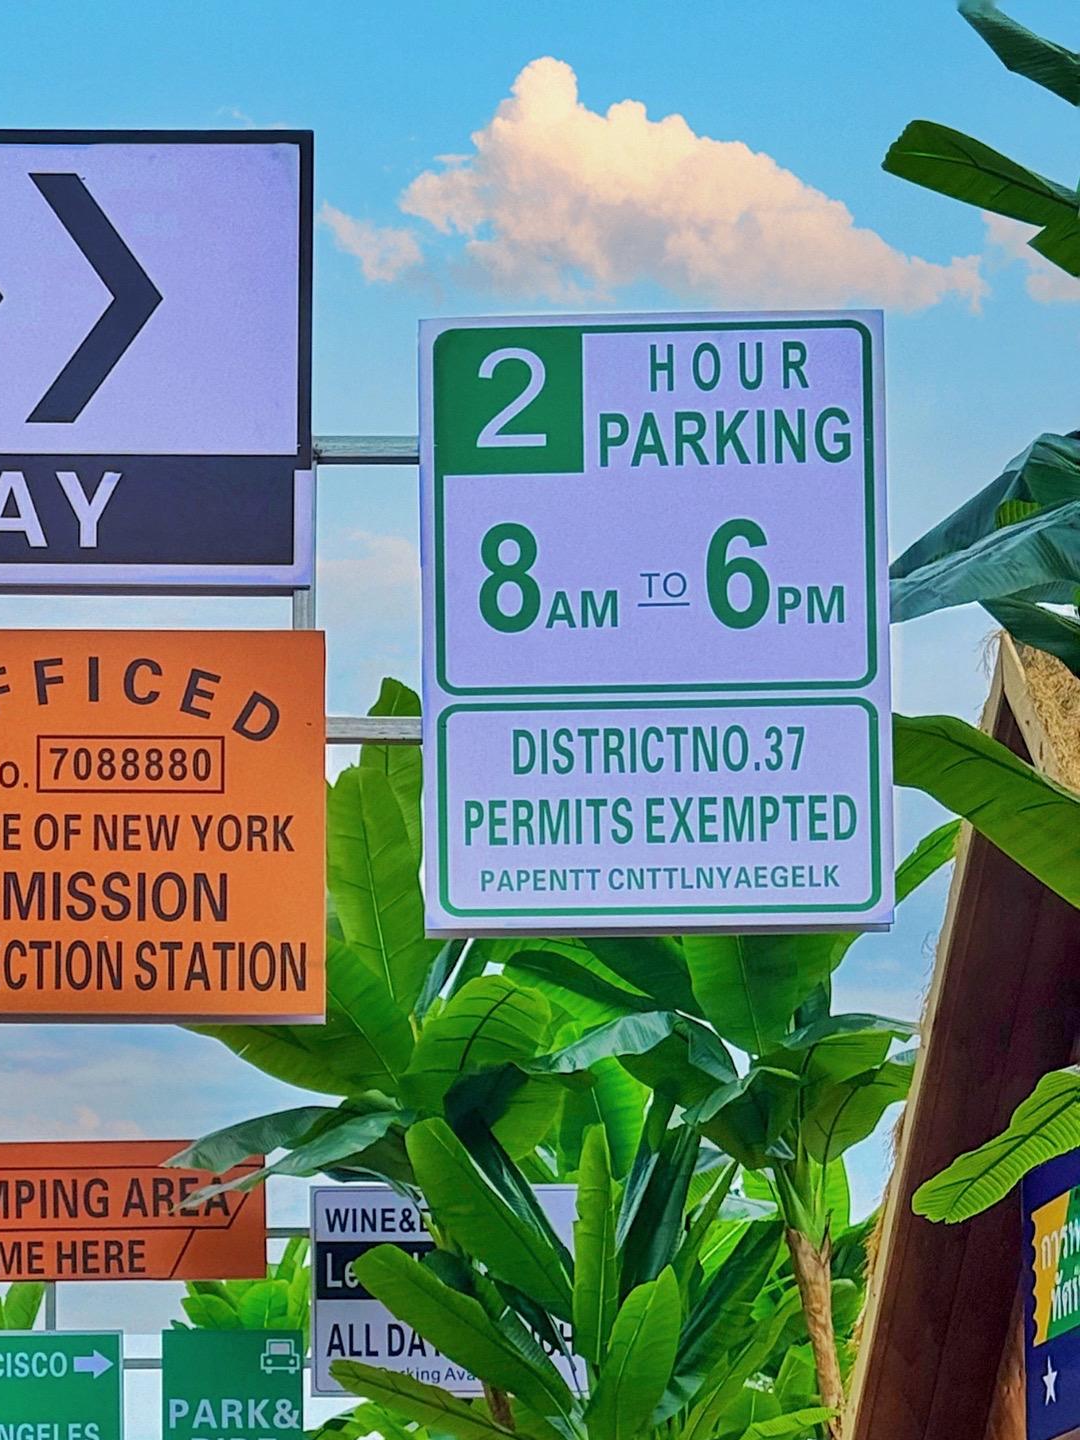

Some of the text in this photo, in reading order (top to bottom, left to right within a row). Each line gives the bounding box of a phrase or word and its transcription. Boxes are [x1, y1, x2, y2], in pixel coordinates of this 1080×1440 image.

[649, 340, 810, 392] HOUR
[476, 347, 547, 449] 2
[598, 407, 852, 467] PARKING
[640, 572, 688, 600] TO
[49, 747, 212, 782] 7088880
[33, 813, 82, 851] OF
[93, 814, 180, 852] NEW
[191, 814, 295, 853] YORK
[464, 794, 858, 846] PERMITS EXEMPTED
[480, 867, 602, 893] PAPENTT
[134, 941, 307, 992] STATION
[122, 1176, 230, 1218] AREA
[56, 1239, 146, 1274] HERE
[326, 1323, 440, 1357] ALL DA
[168, 1398, 301, 1430] PARK&
